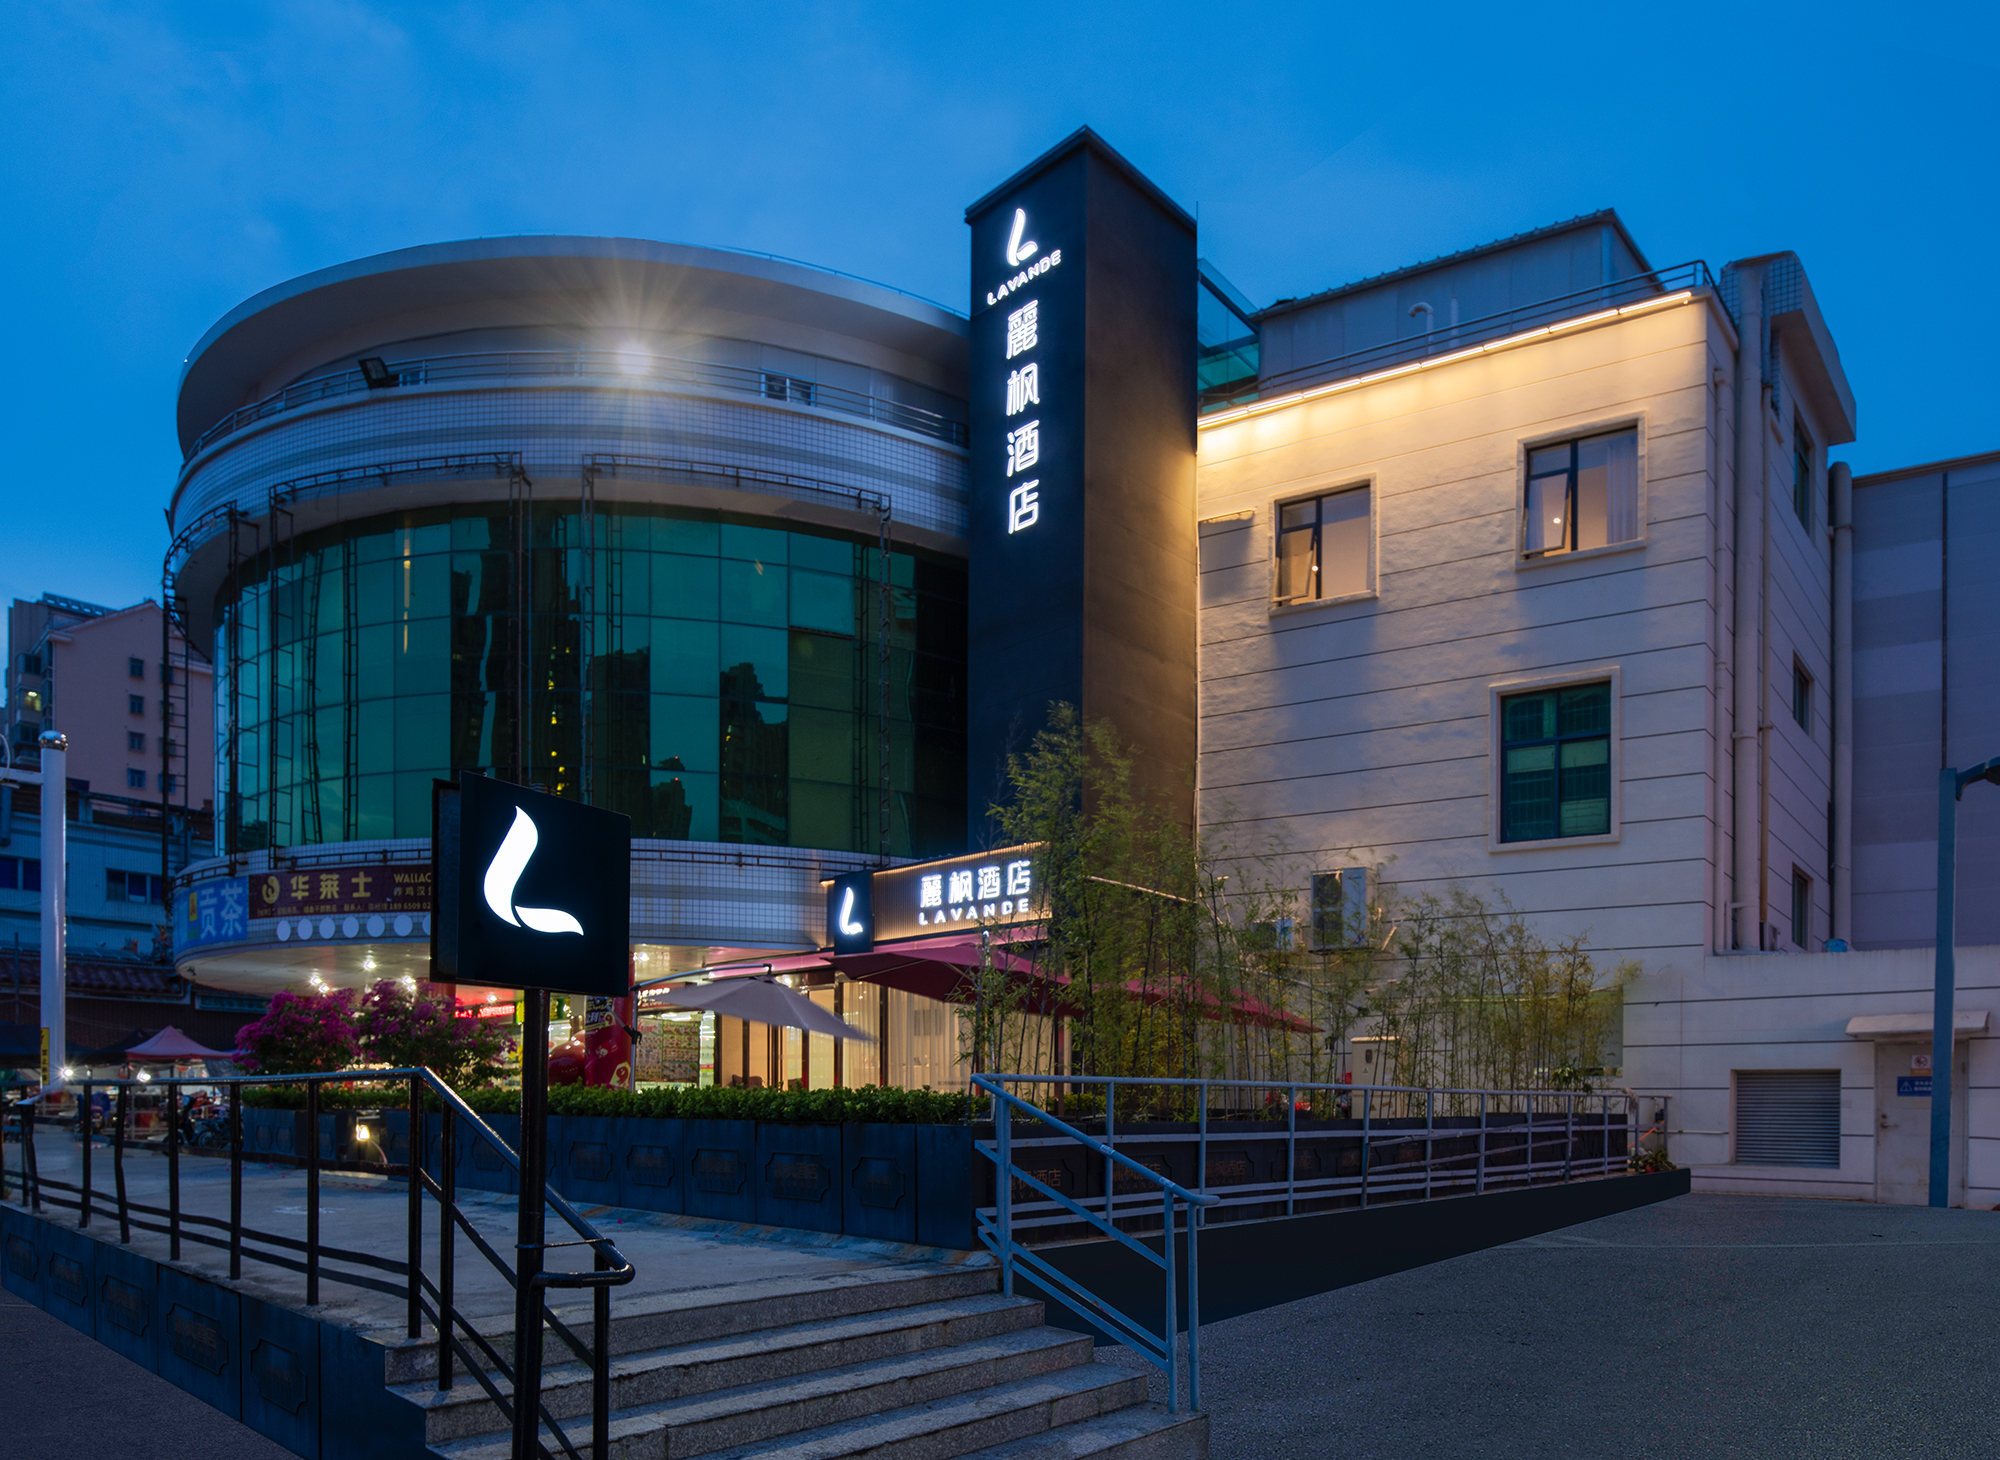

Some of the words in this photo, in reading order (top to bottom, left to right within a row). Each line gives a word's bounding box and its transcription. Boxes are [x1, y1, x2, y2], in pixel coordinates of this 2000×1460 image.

[986, 248, 1063, 306] LAVANDE
[1005, 299, 1041, 535] 麗枫酒店
[290, 871, 373, 901] 华莱士
[393, 886, 432, 897] 炸鸡汉
[920, 860, 1031, 907] 麗枫酒店
[200, 882, 243, 940] 贡茶
[918, 897, 1031, 927] LAVANDE
